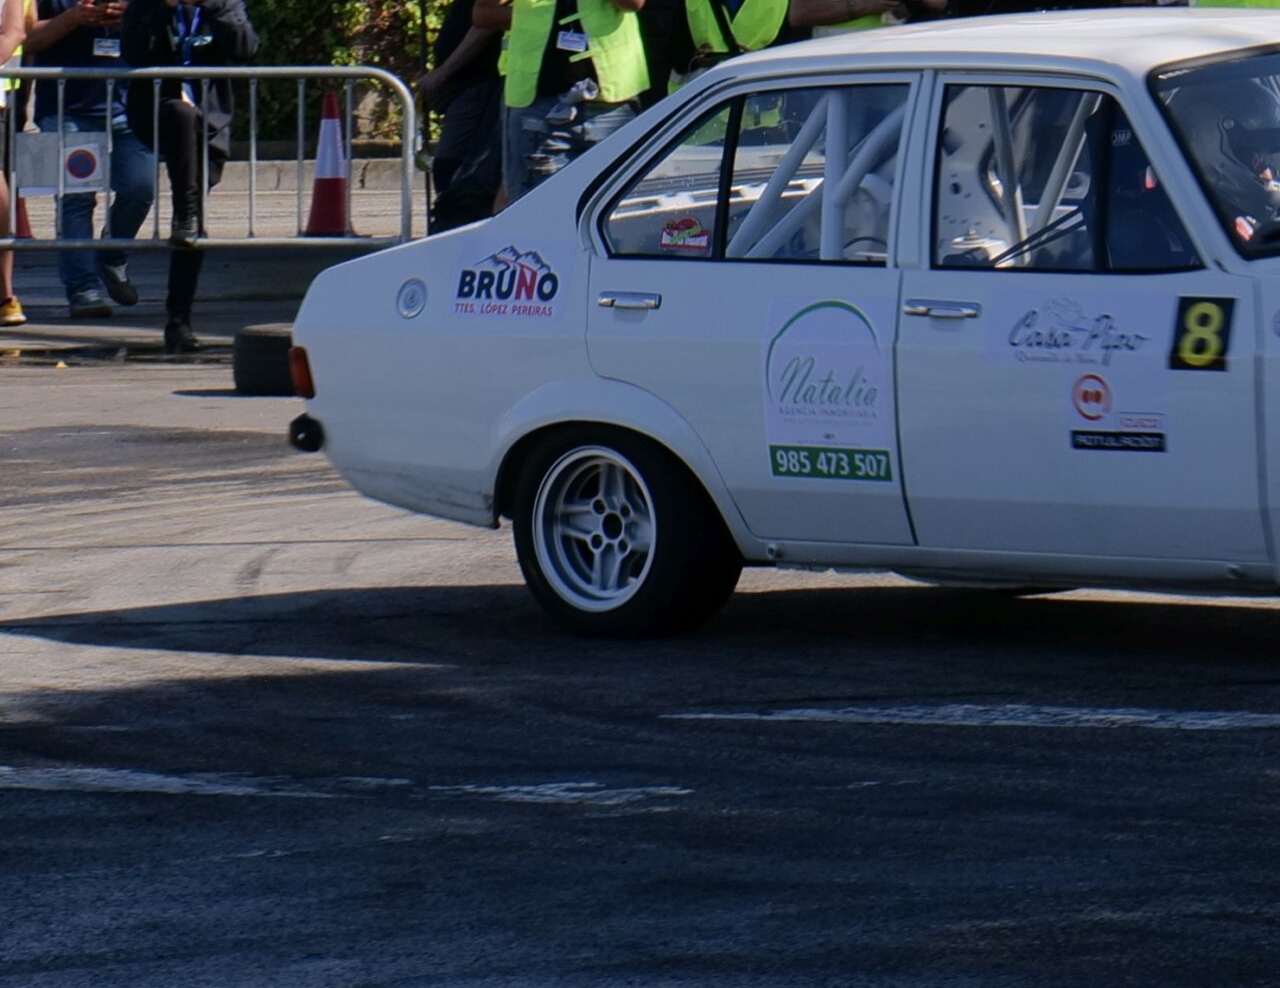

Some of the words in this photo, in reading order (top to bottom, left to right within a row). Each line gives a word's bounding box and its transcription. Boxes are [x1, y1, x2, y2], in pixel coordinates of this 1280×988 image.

[457, 269, 559, 302] BRUNO
[511, 305, 553, 317] PEREIRAS
[1179, 302, 1224, 367] 8
[779, 356, 879, 407] Natalia
[776, 449, 811, 473] 985
[816, 452, 850, 475] 473
[854, 454, 887, 477] 507
